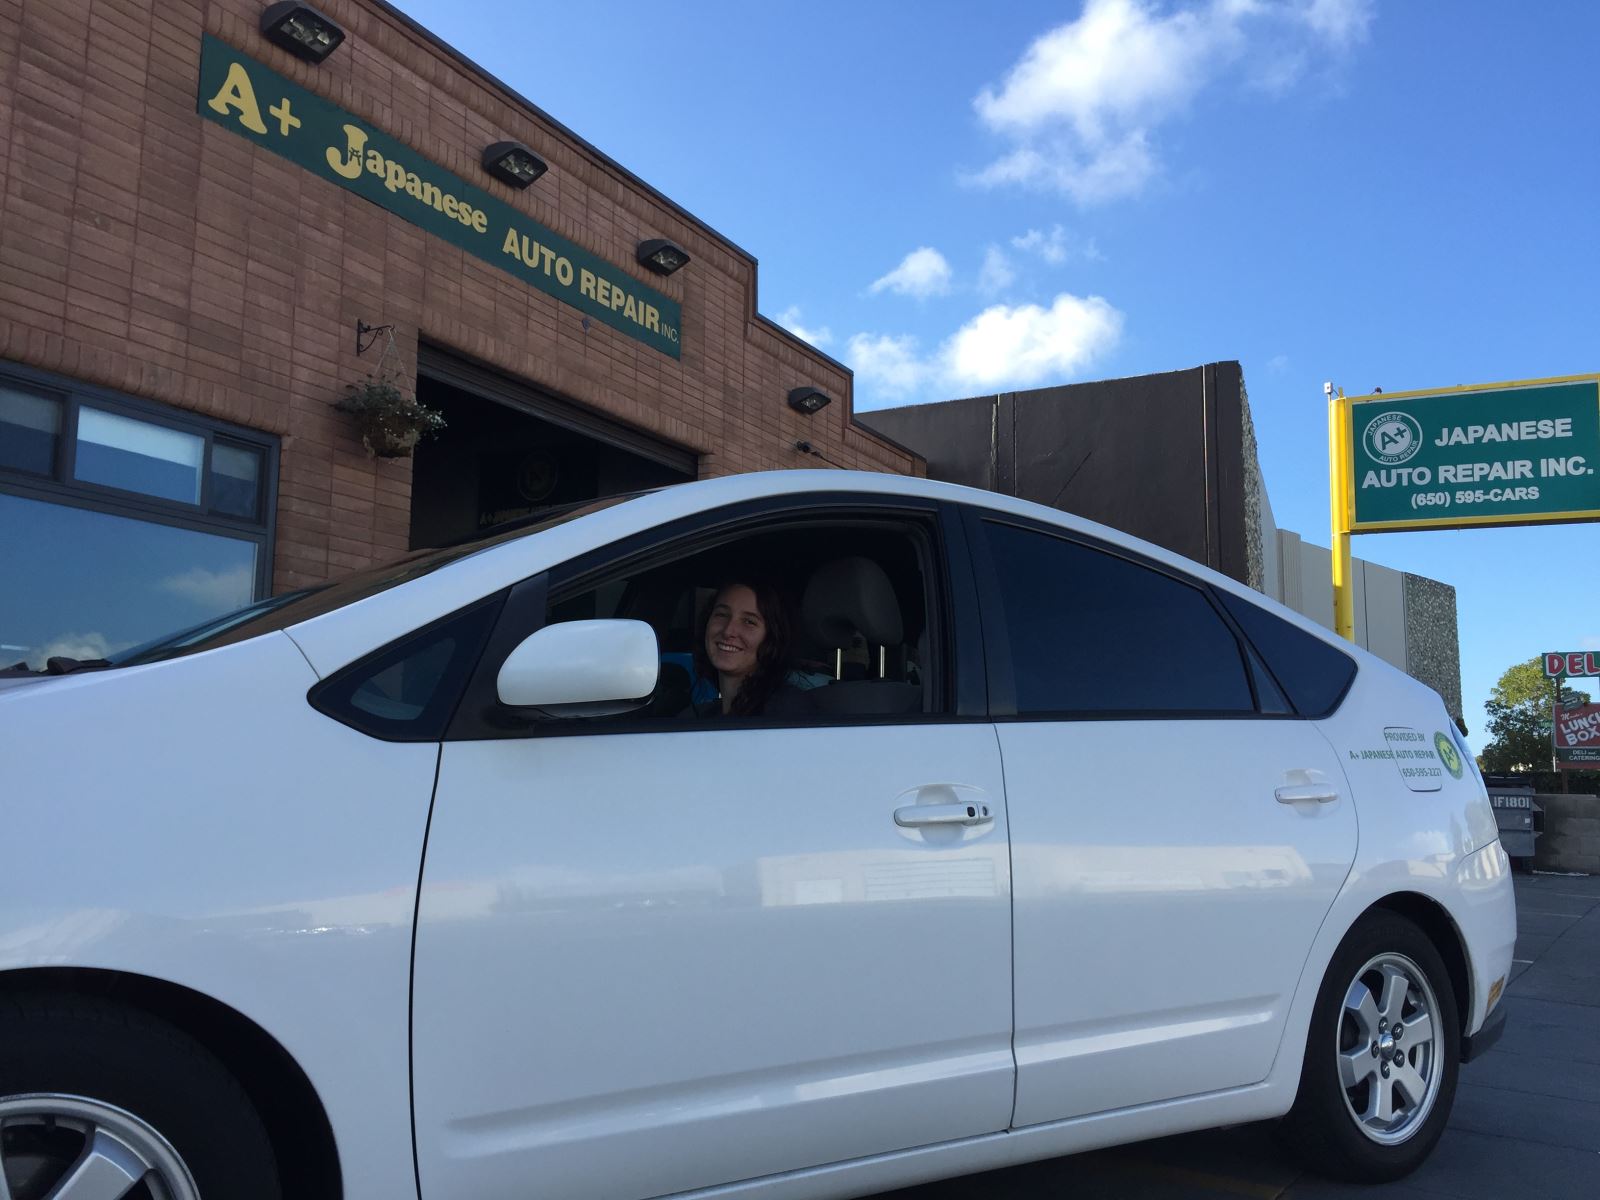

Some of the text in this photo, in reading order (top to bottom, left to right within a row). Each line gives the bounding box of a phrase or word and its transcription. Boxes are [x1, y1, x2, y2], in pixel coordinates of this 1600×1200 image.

[208, 62, 679, 344] A+ Japanese AUTO REPAIR INC.
[1368, 414, 1402, 436] JAPANESE
[1434, 418, 1573, 447] JAPANESE
[1381, 427, 1408, 450] A+
[1399, 440, 1419, 460] REPAIR
[1362, 456, 1594, 489] AUTO REPAIR INC.
[1411, 487, 1540, 509] (650) 595-CARS
[1385, 732, 1417, 742] PROVIDED
[1565, 726, 1600, 746] BOX
[1360, 750, 1395, 760] JAPANESE
[1395, 750, 1414, 760] AUTO
